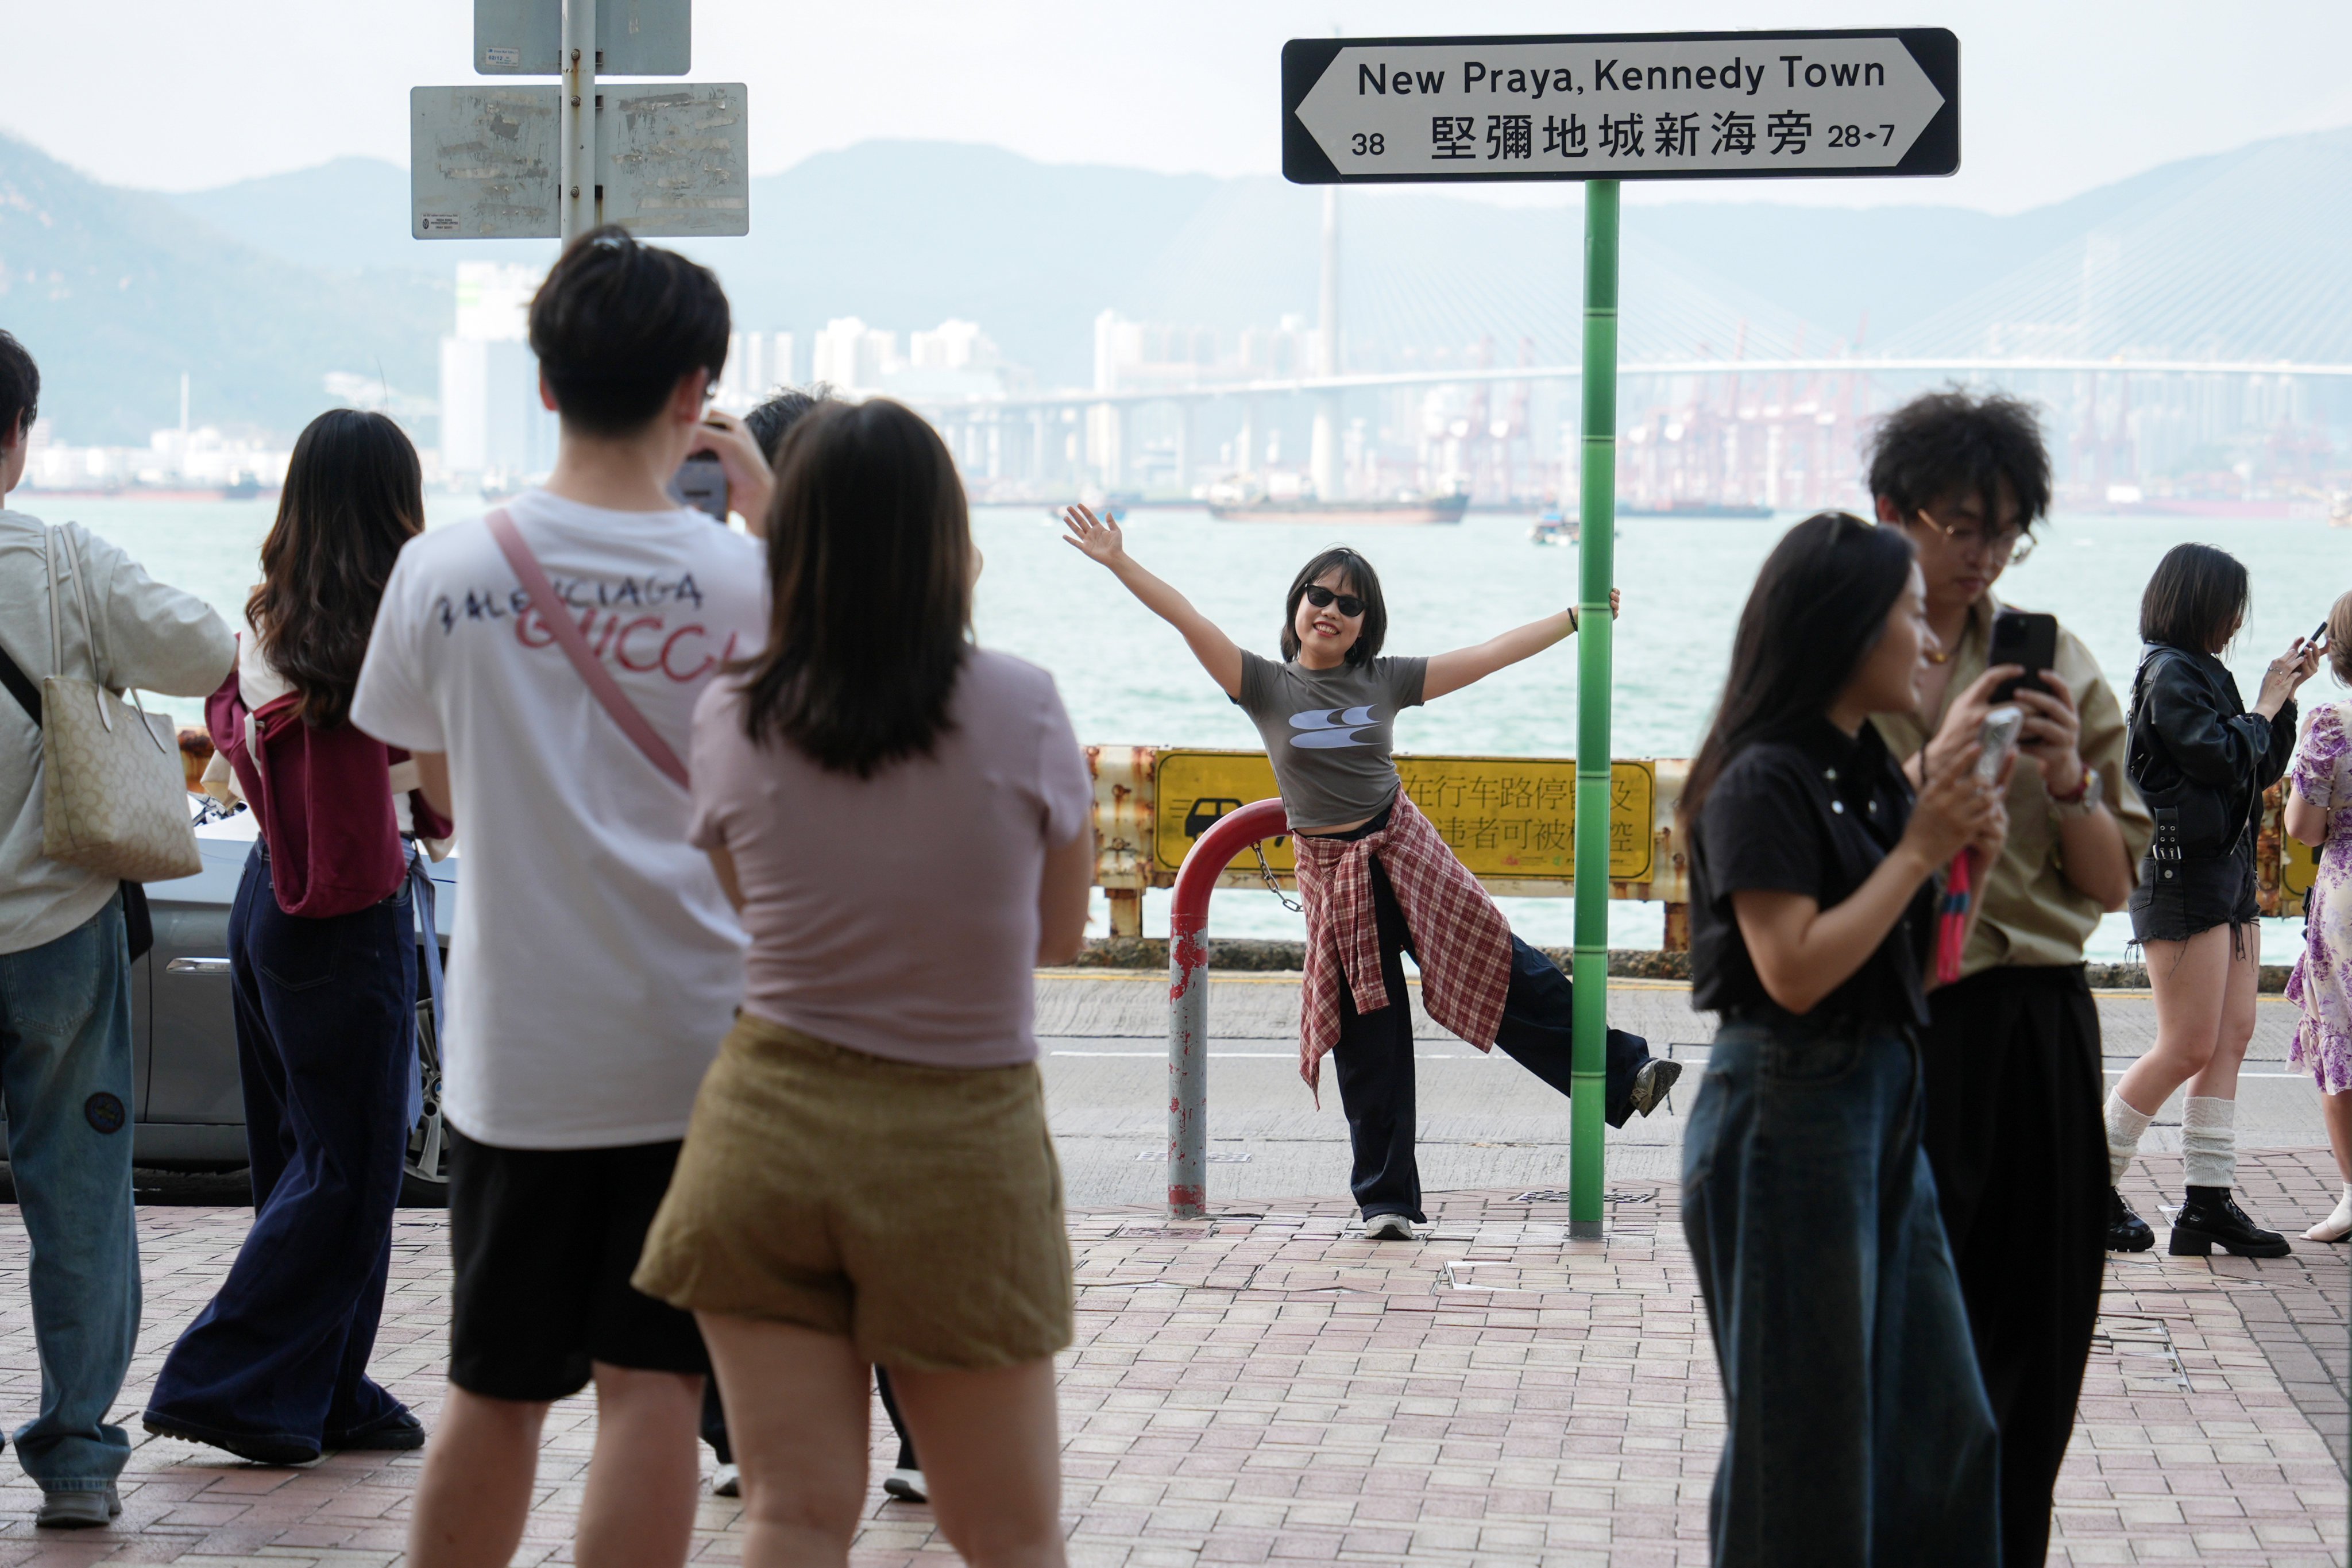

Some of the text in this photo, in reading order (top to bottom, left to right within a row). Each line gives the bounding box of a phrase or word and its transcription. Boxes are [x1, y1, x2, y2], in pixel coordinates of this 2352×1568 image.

[1360, 55, 1884, 99] New Praya, Kennedy Town
[1351, 133, 1385, 156] 38
[1431, 109, 1812, 160] 堅彌地城新海旁
[435, 573, 702, 635] BALECIAGA
[1405, 774, 1632, 812] 在行车路停及
